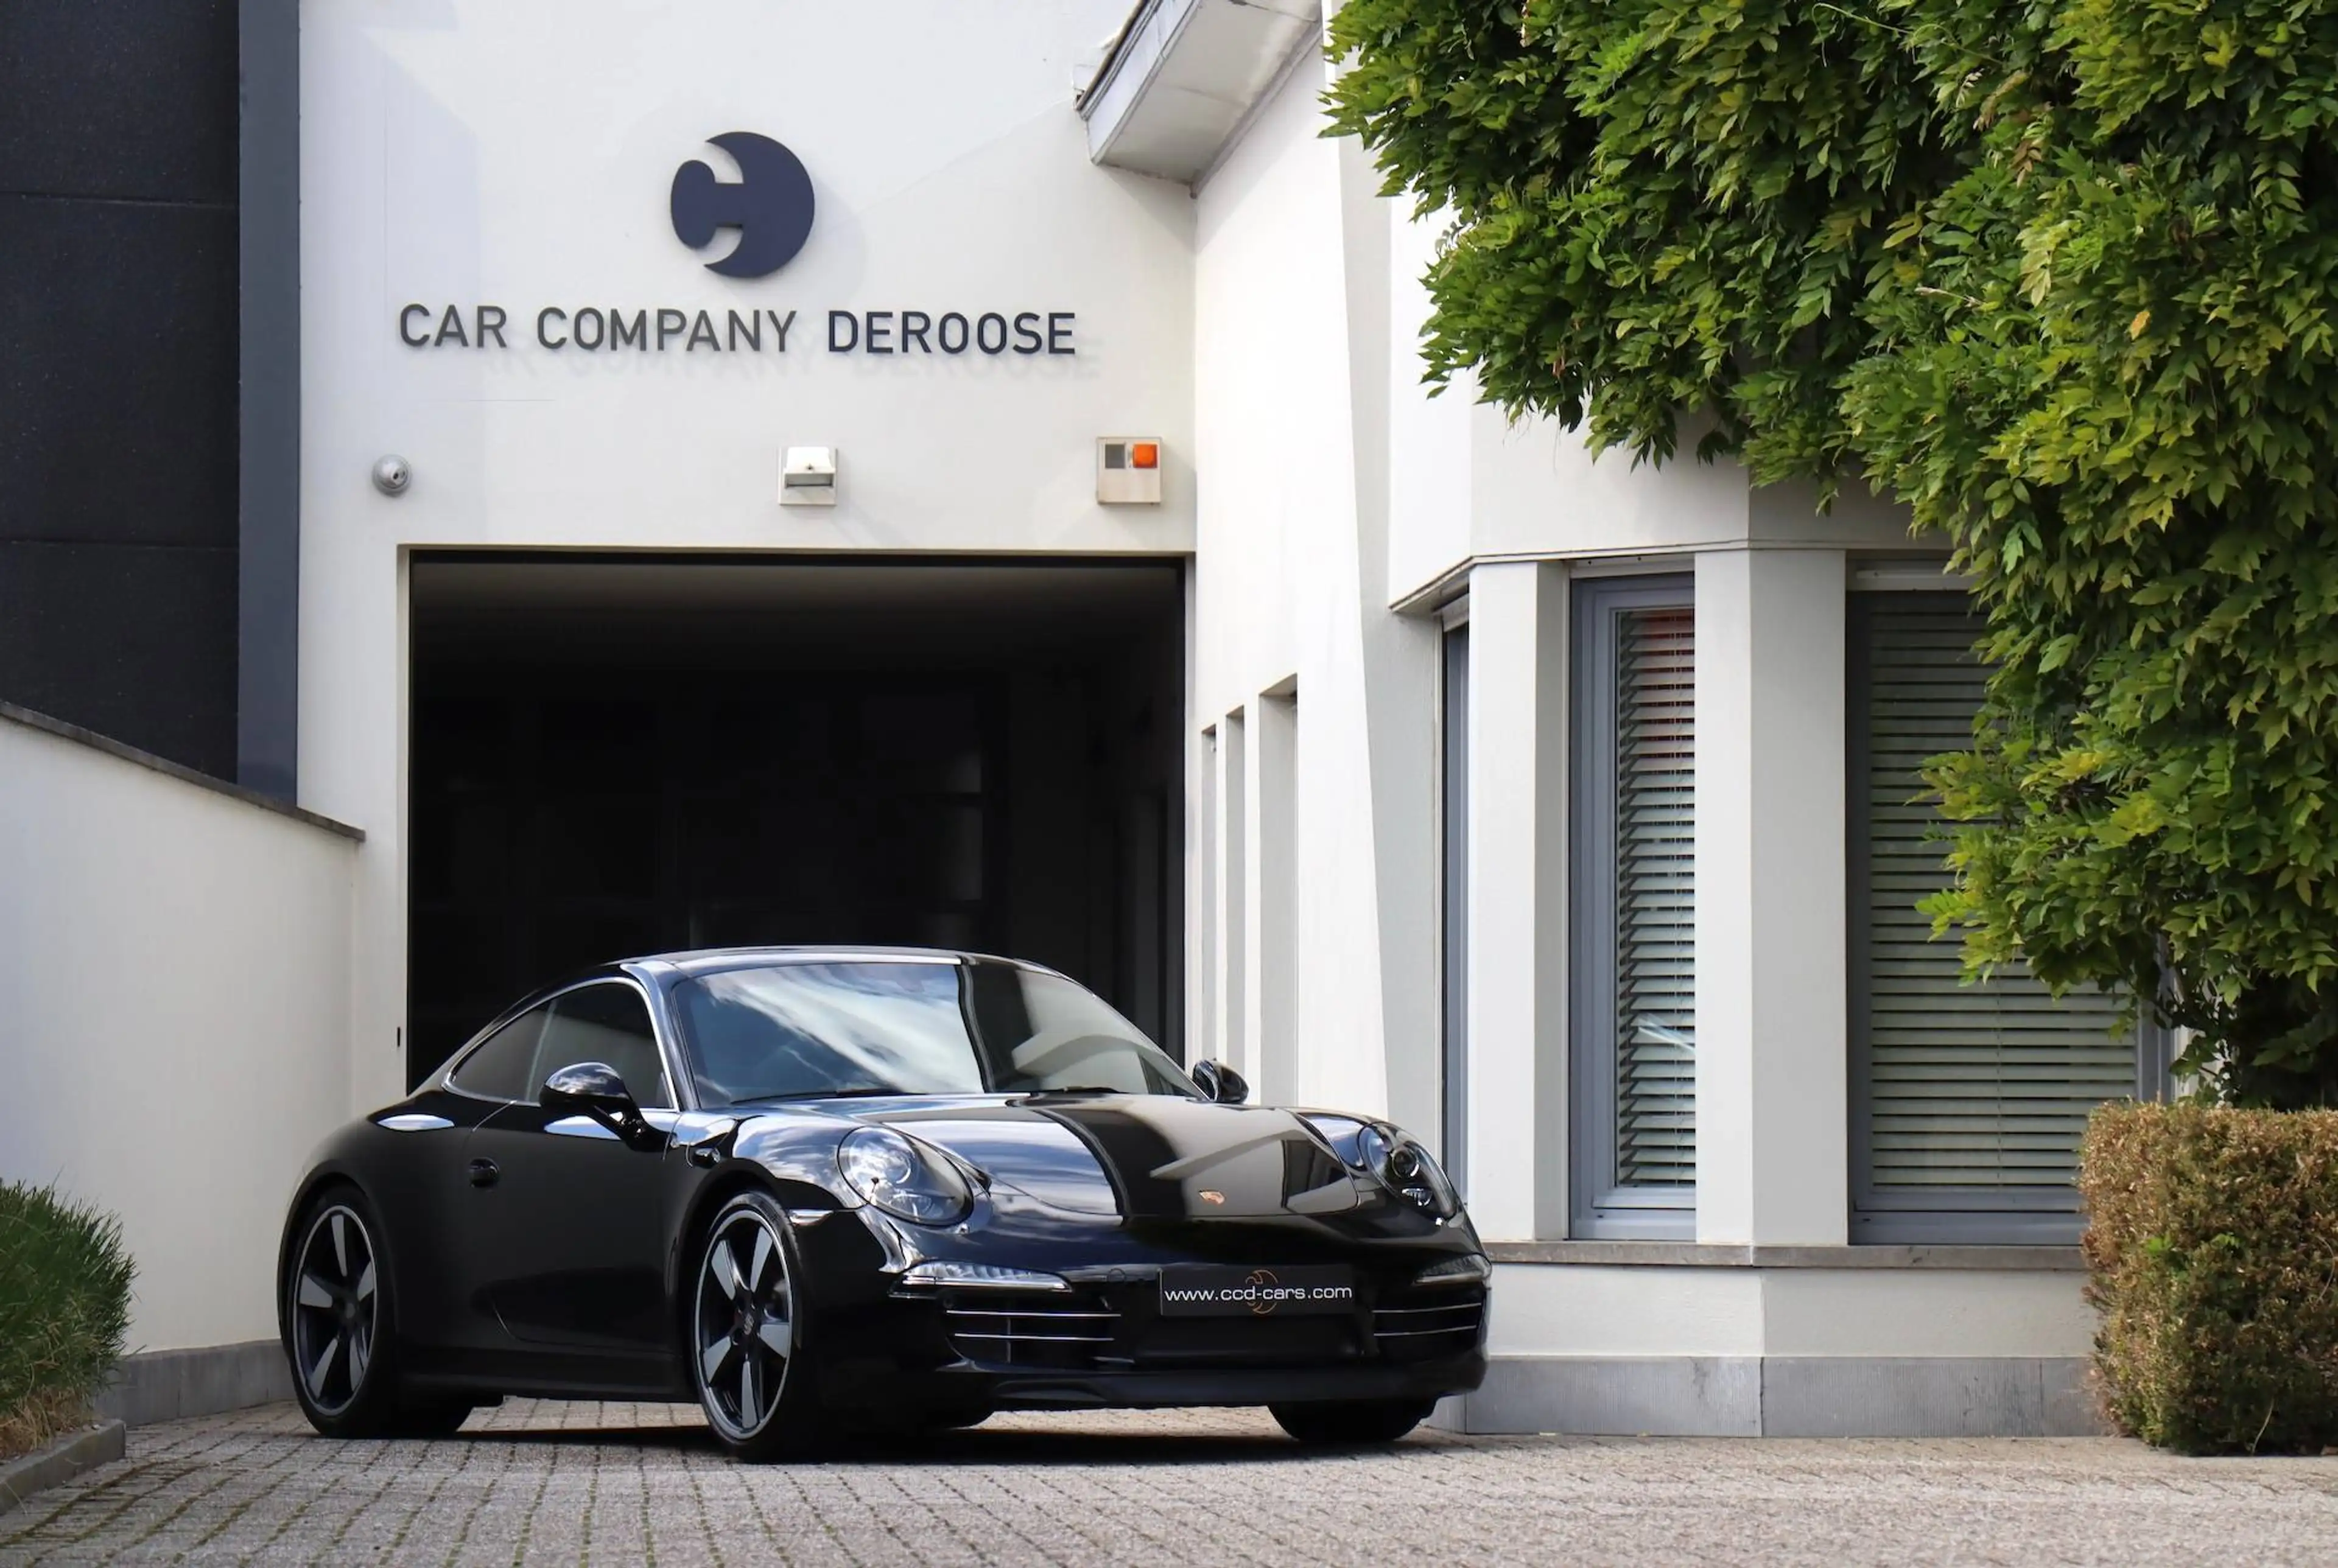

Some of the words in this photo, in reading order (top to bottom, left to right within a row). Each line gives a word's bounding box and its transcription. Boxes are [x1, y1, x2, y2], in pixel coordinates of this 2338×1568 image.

[399, 304, 507, 348] CAR
[538, 307, 797, 352] COMPANY
[828, 310, 1076, 355] DEROOSE
[1164, 1286, 1353, 1301] www.ccd-cars.com
